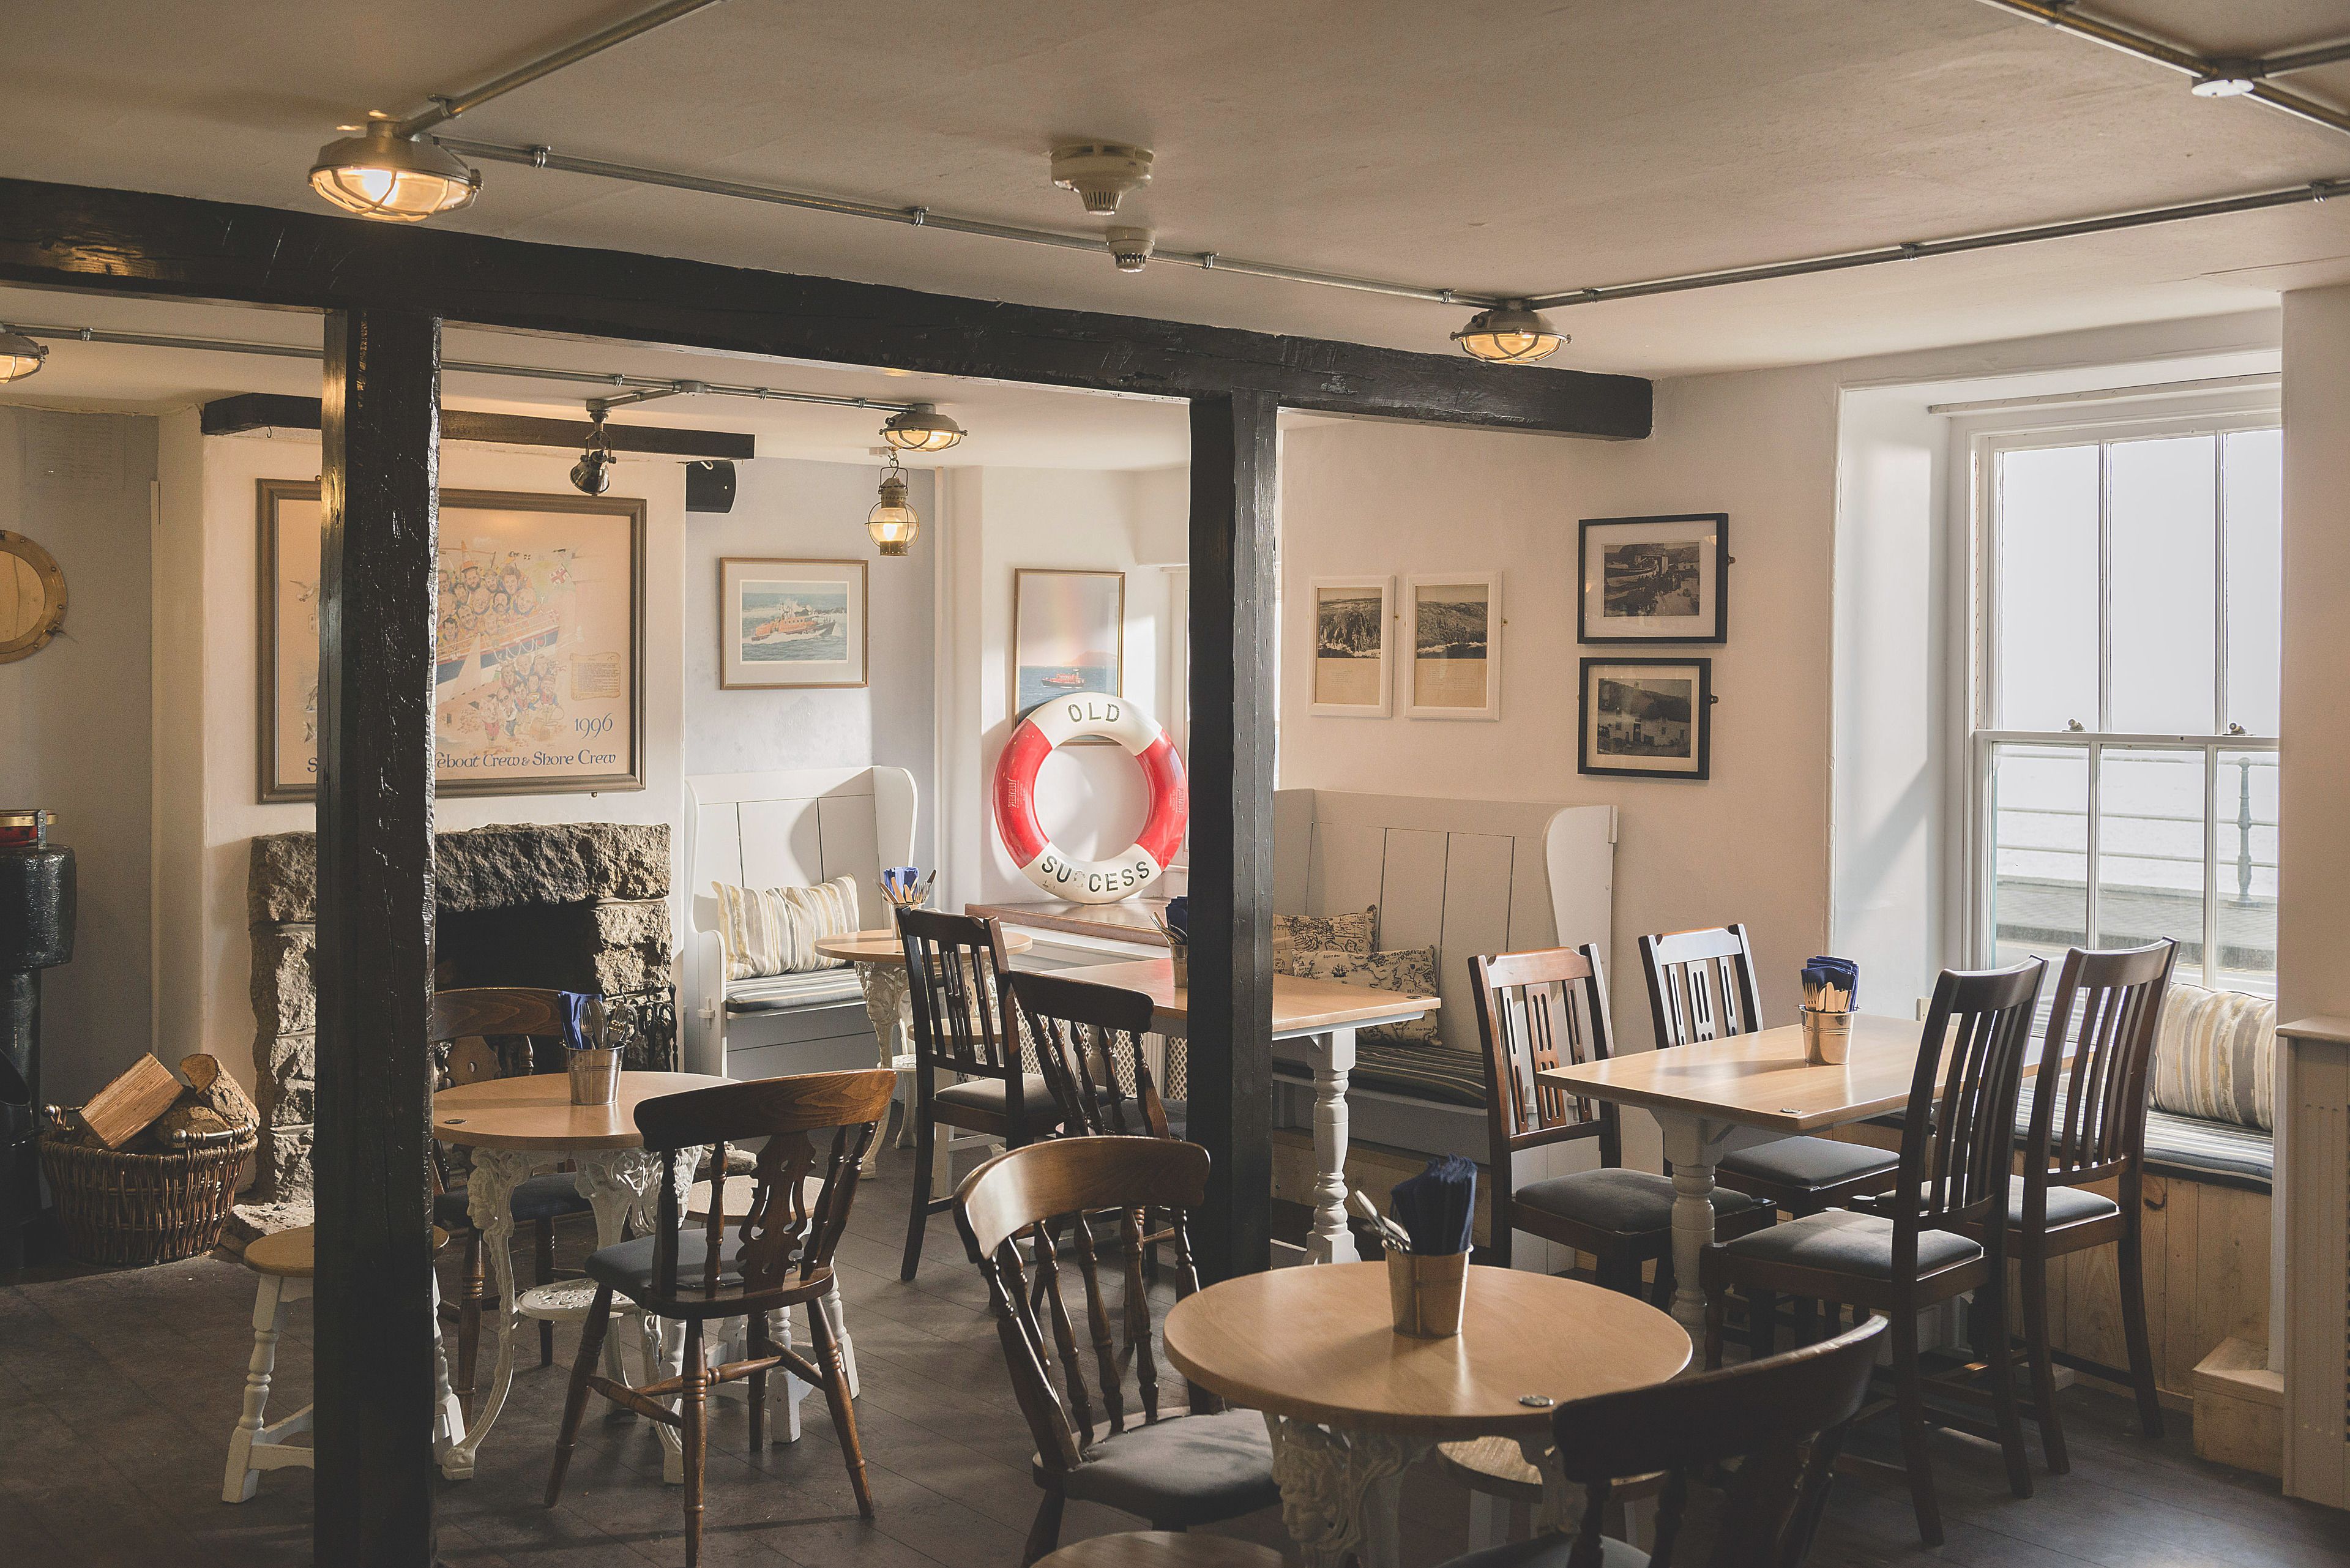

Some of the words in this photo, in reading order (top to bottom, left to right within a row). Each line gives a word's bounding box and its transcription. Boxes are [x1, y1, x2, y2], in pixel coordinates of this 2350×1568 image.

[1068, 702, 1120, 723] OLD
[575, 713, 613, 740] 1996
[435, 752, 480, 768] feboat
[483, 753, 520, 767] Crew
[521, 757, 530, 766] &
[532, 751, 574, 766] Shore
[578, 749, 616, 764] Crew
